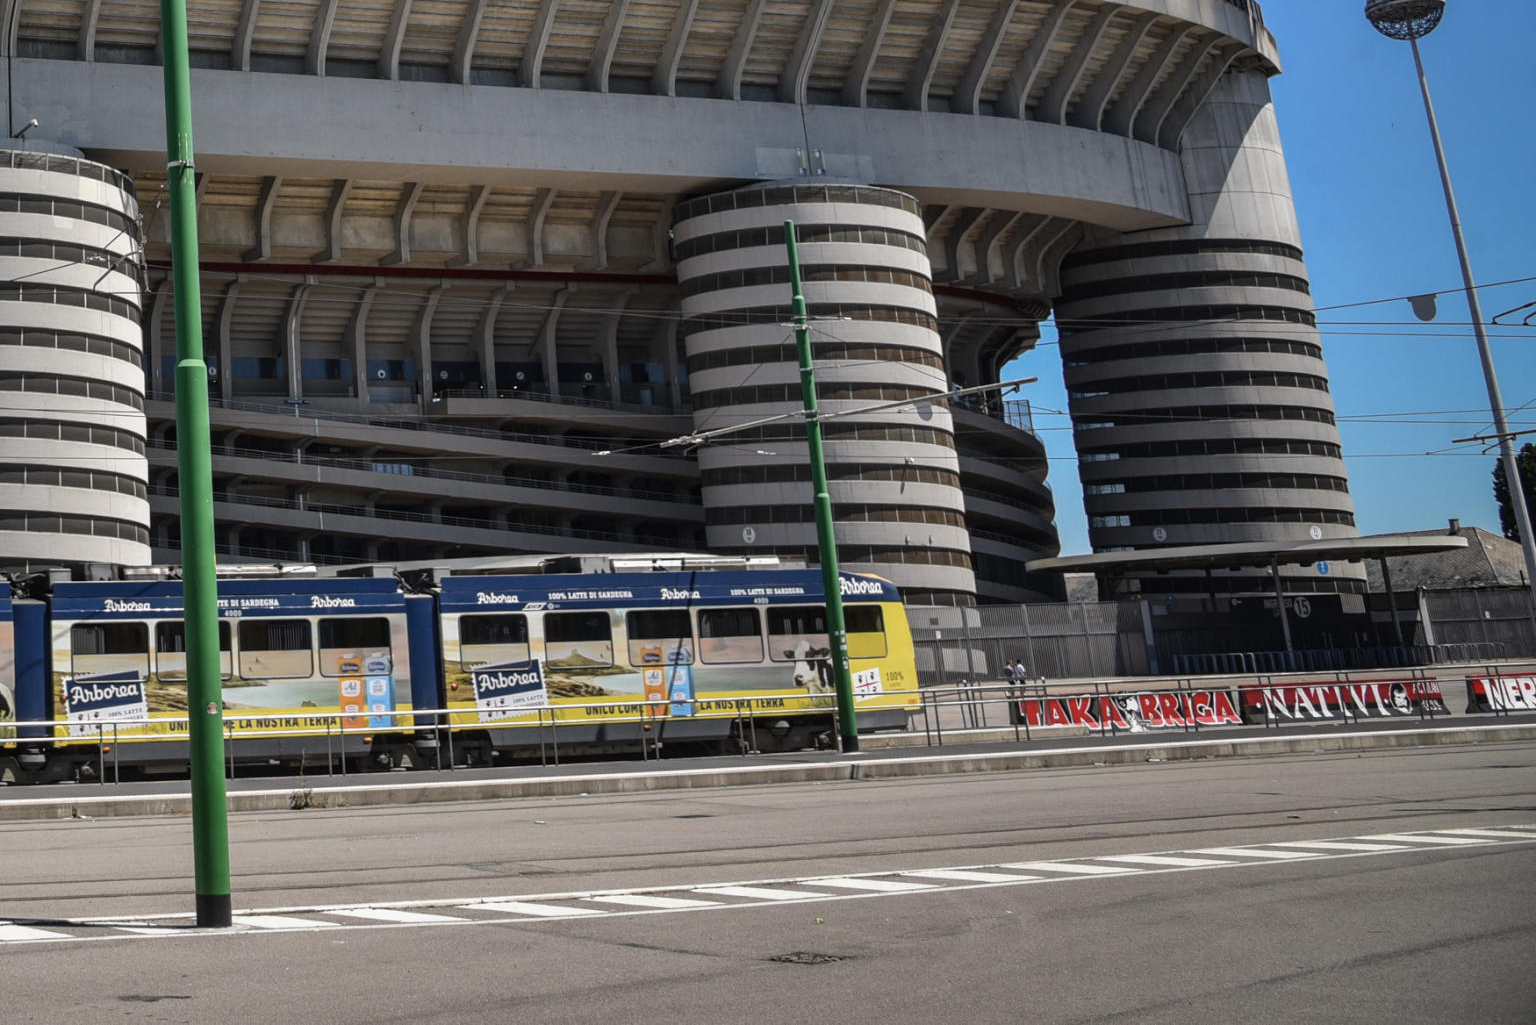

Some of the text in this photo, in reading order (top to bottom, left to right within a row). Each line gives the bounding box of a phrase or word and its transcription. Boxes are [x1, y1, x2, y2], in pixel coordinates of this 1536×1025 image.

[838, 577, 884, 595] Arborea
[477, 592, 519, 605] Arborea
[548, 592, 567, 600] 100%
[568, 591, 588, 599] LATTE
[589, 591, 597, 599] DI
[660, 588, 701, 600] Arborea
[104, 599, 151, 613] Arborea
[230, 599, 239, 607] DI
[240, 598, 279, 607] SARDEGNA
[310, 596, 356, 608] Arborea
[224, 609, 242, 617] 4909
[478, 672, 539, 692] Arborea
[885, 671, 904, 682] 100%
[70, 683, 139, 705] Arborea
[1263, 684, 1392, 718] NATIVI
[1480, 679, 1536, 709] NER
[585, 698, 785, 716] UNICO COME LA NOSTRA TERRA
[1019, 690, 1243, 730] TAKA BRIGA
[168, 716, 337, 732] UNI ME LA NOSTRA TERRA
